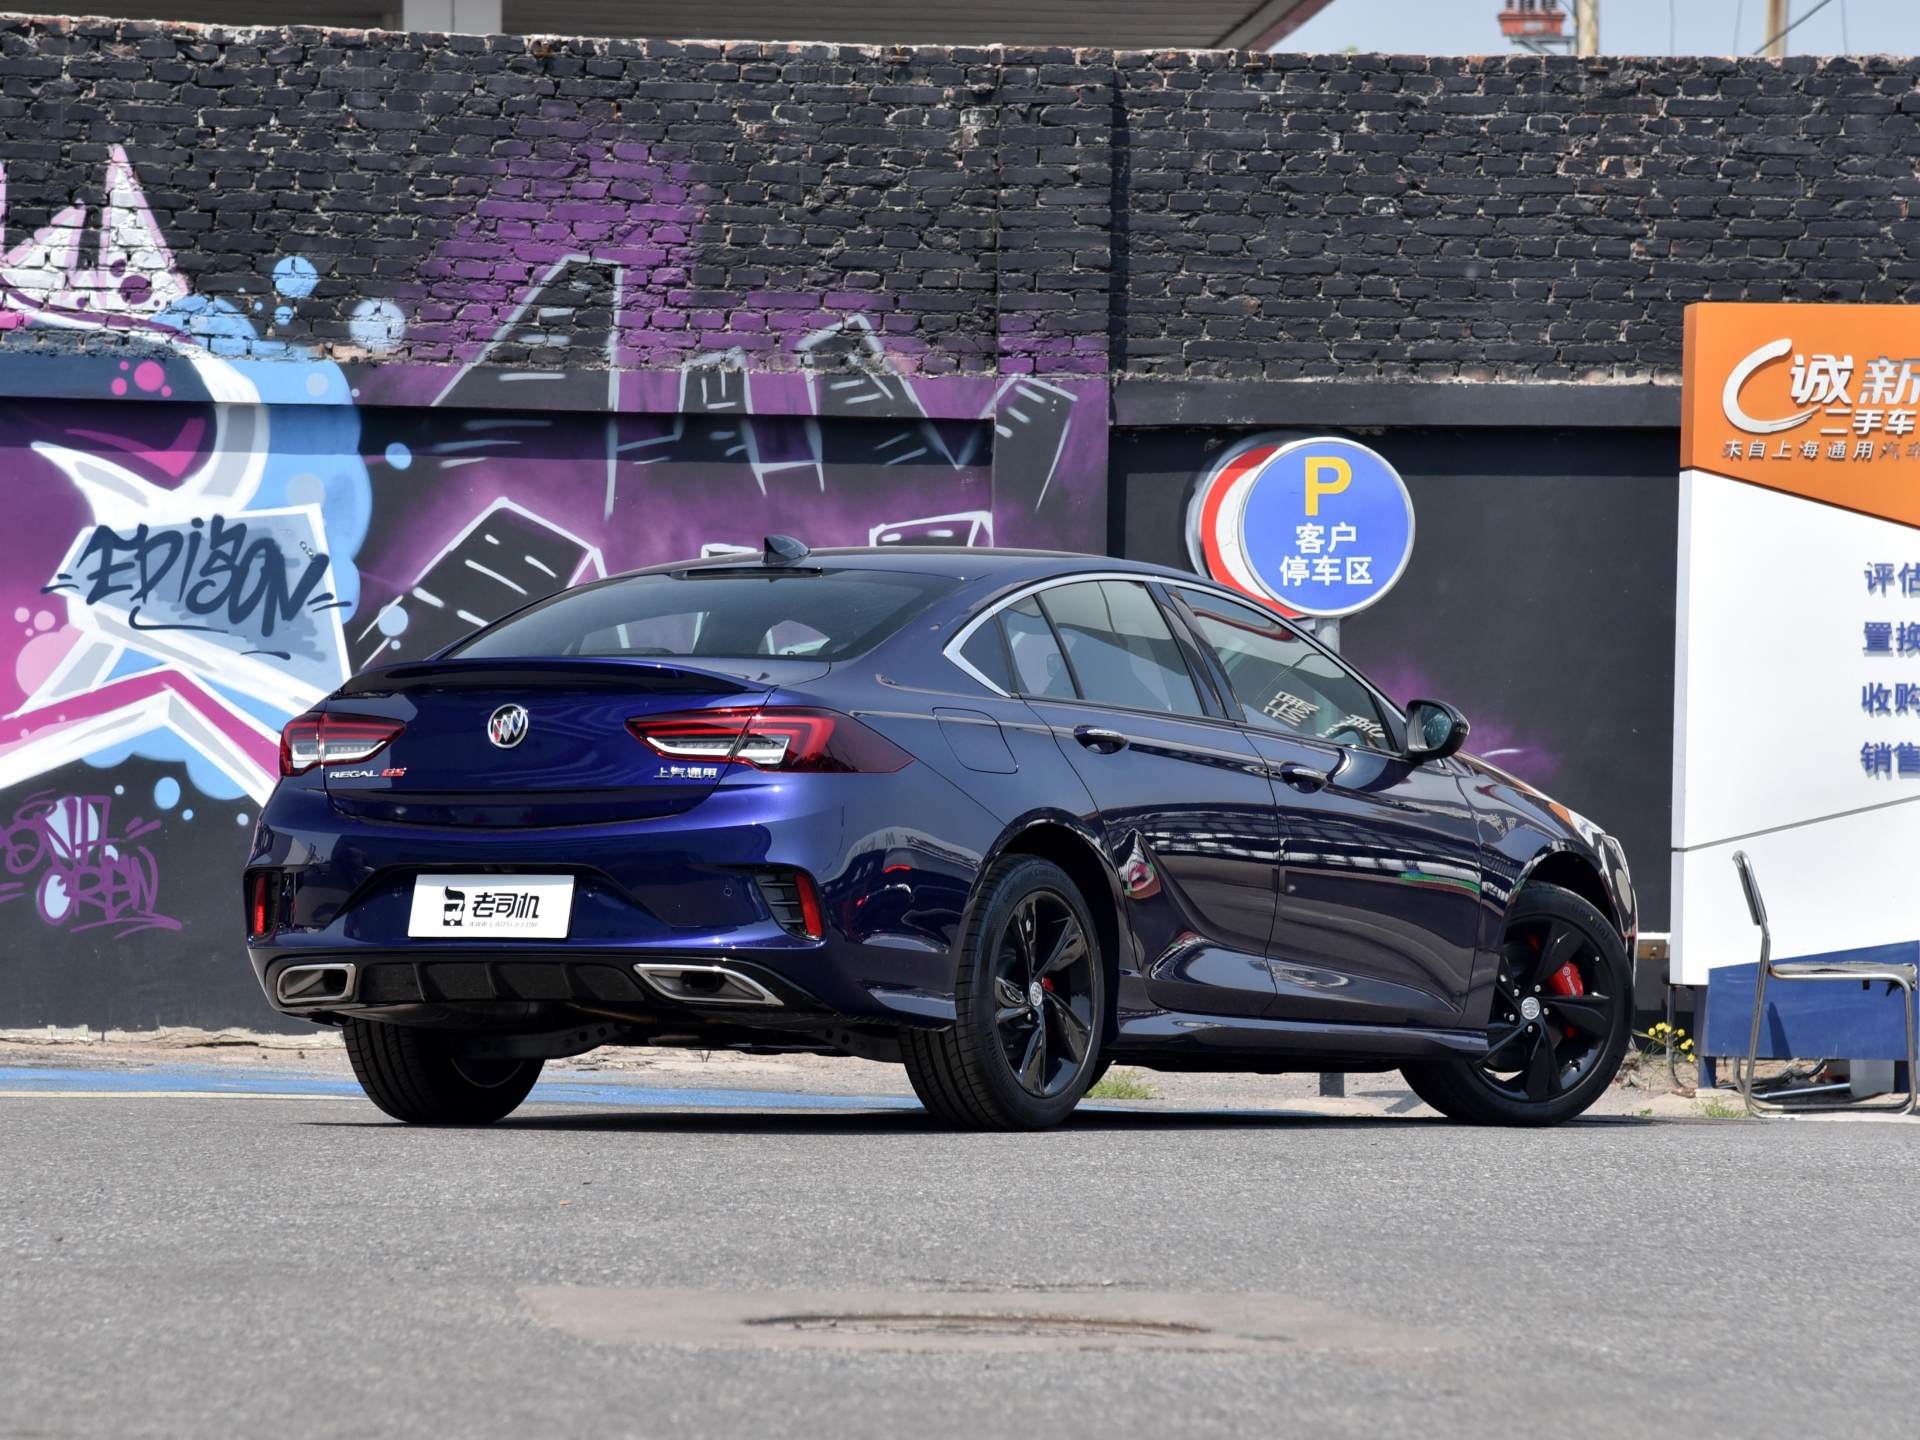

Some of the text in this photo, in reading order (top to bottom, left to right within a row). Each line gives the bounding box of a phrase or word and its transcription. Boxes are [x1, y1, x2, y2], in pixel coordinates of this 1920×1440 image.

[1791, 355, 1920, 405] 诚新
[1820, 408, 1917, 435] 二手车
[1305, 456, 1352, 516] P
[1295, 521, 1357, 554] 客户
[1279, 555, 1373, 587] 停车区
[329, 769, 379, 778] REGAL
[653, 766, 718, 779] 上汽通用
[472, 892, 540, 919] 老司机
